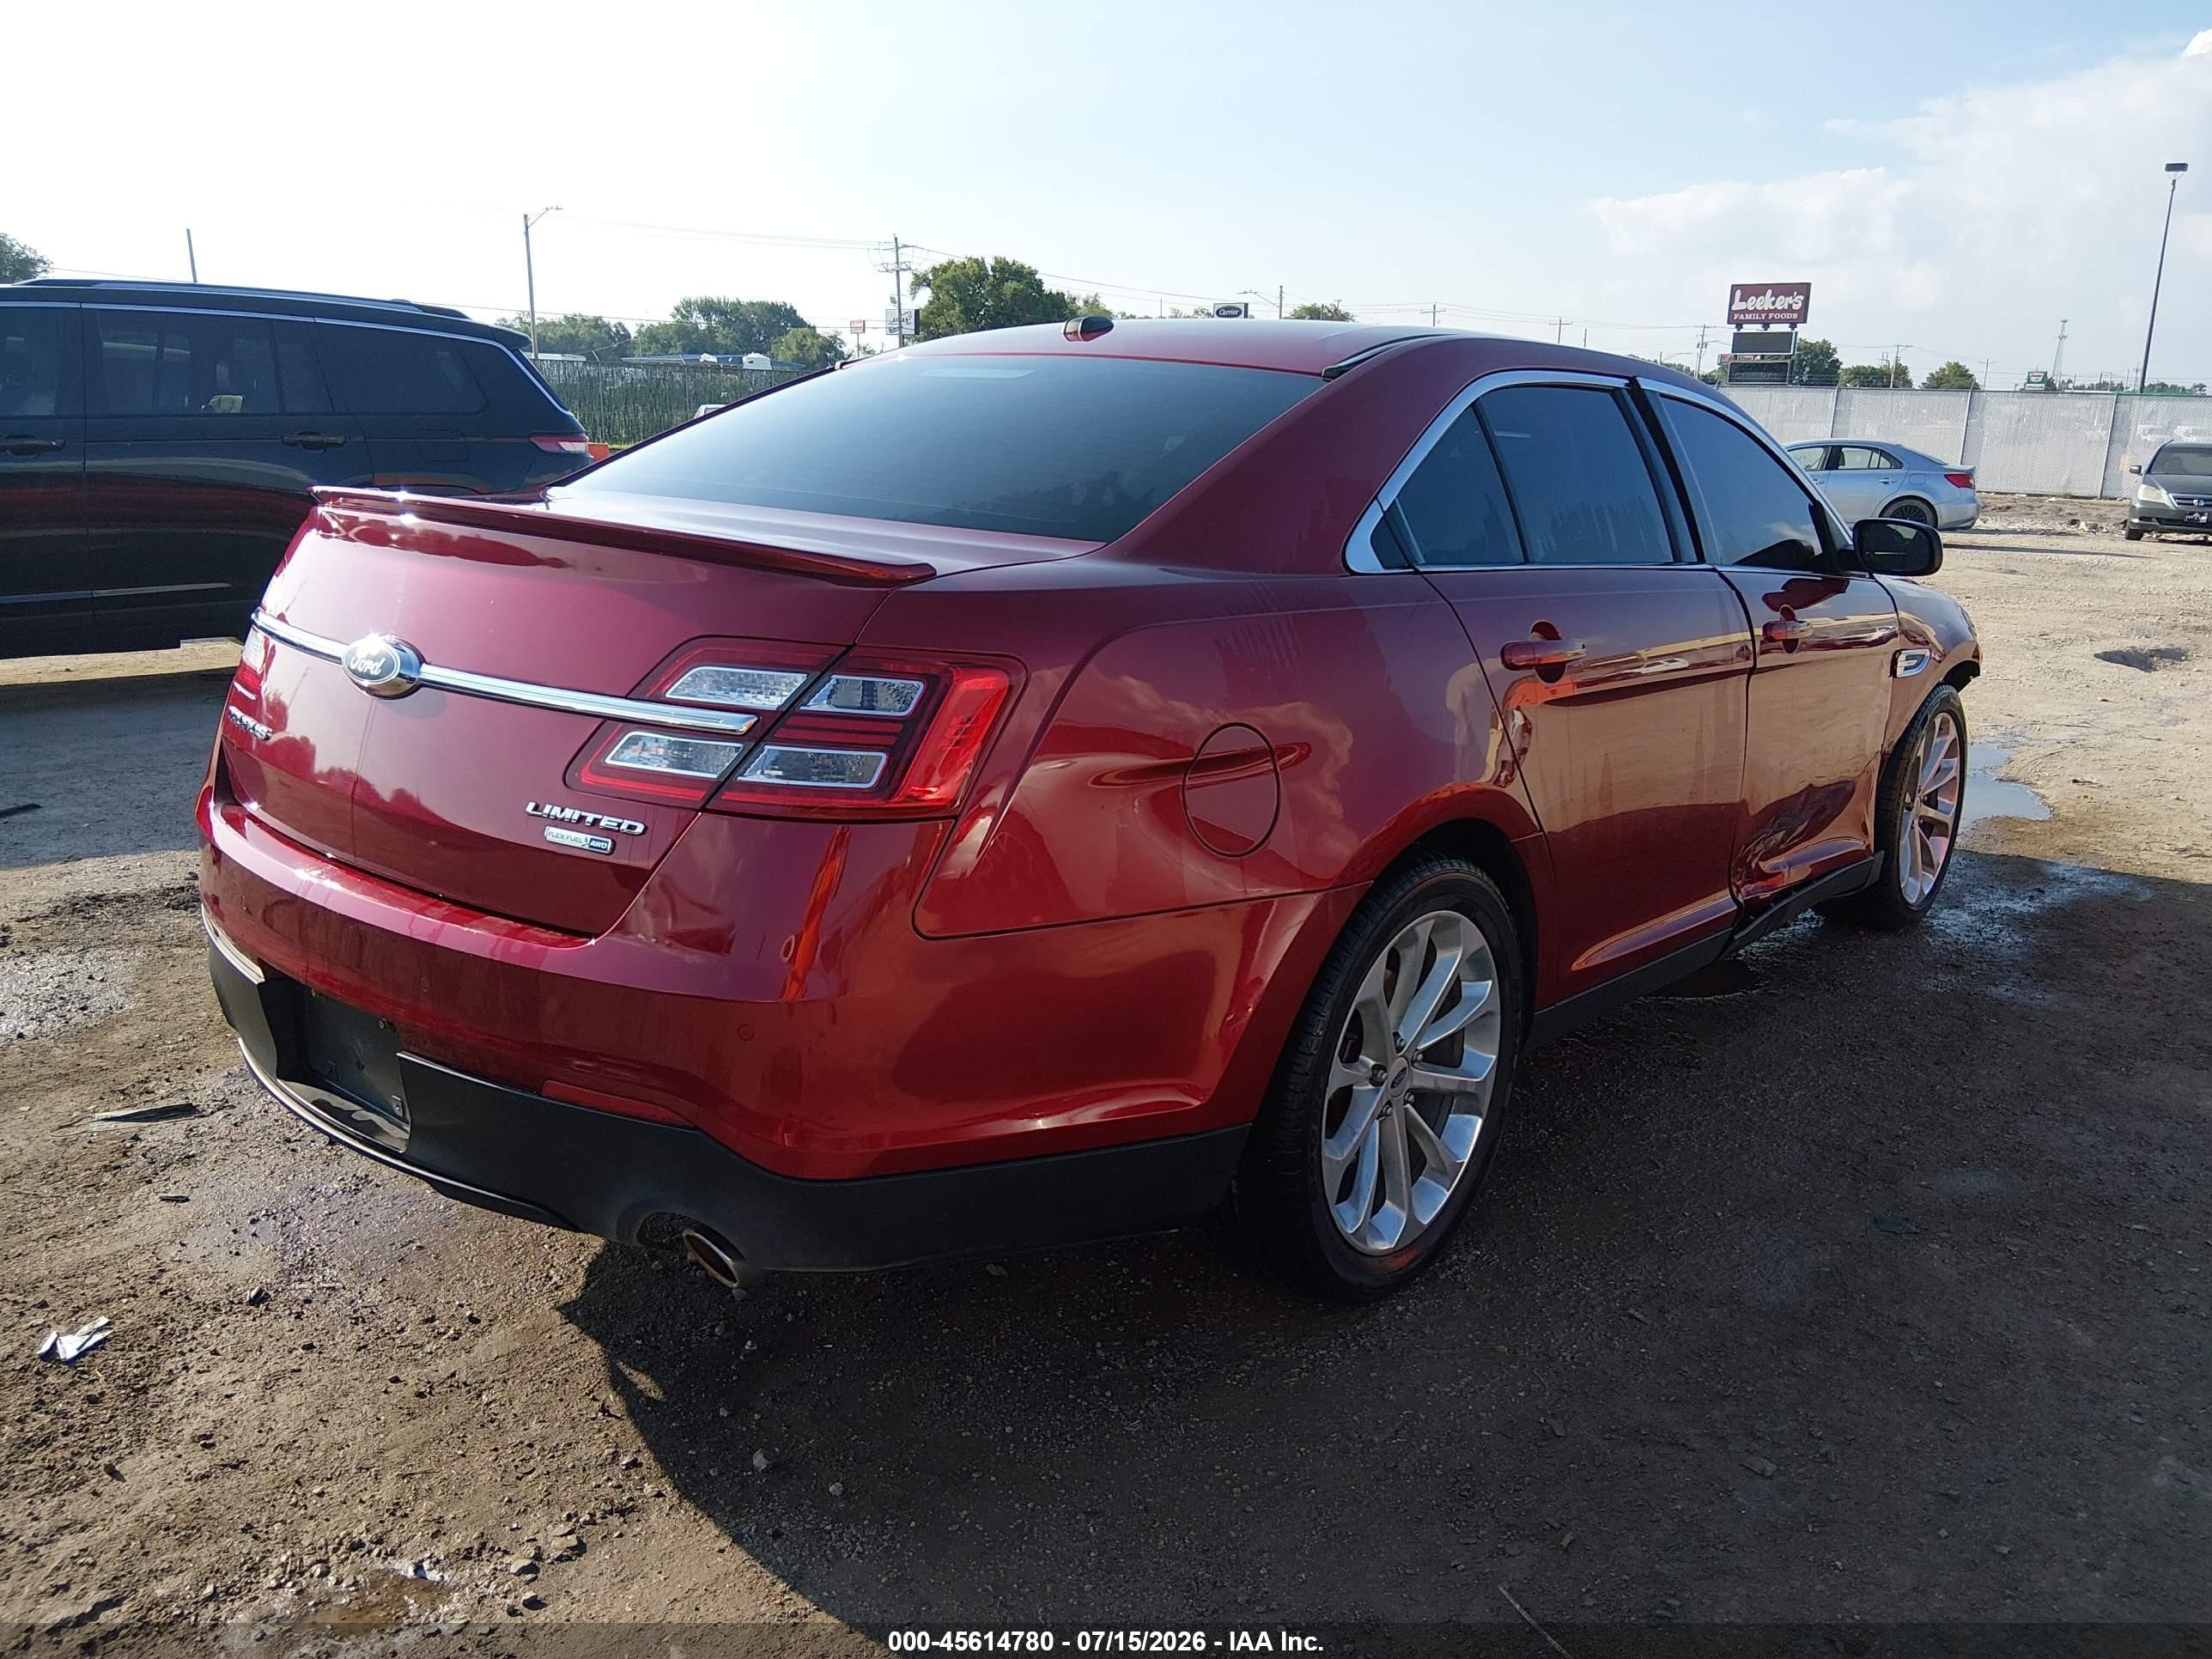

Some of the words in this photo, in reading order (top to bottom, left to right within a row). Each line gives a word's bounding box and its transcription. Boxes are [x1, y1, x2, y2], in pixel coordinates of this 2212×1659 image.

[1731, 289, 1805, 311] Leeker's
[526, 801, 646, 836] LIMITED
[548, 830, 565, 841] FLEX
[566, 835, 583, 844] FUEL
[590, 840, 607, 849] AWD
